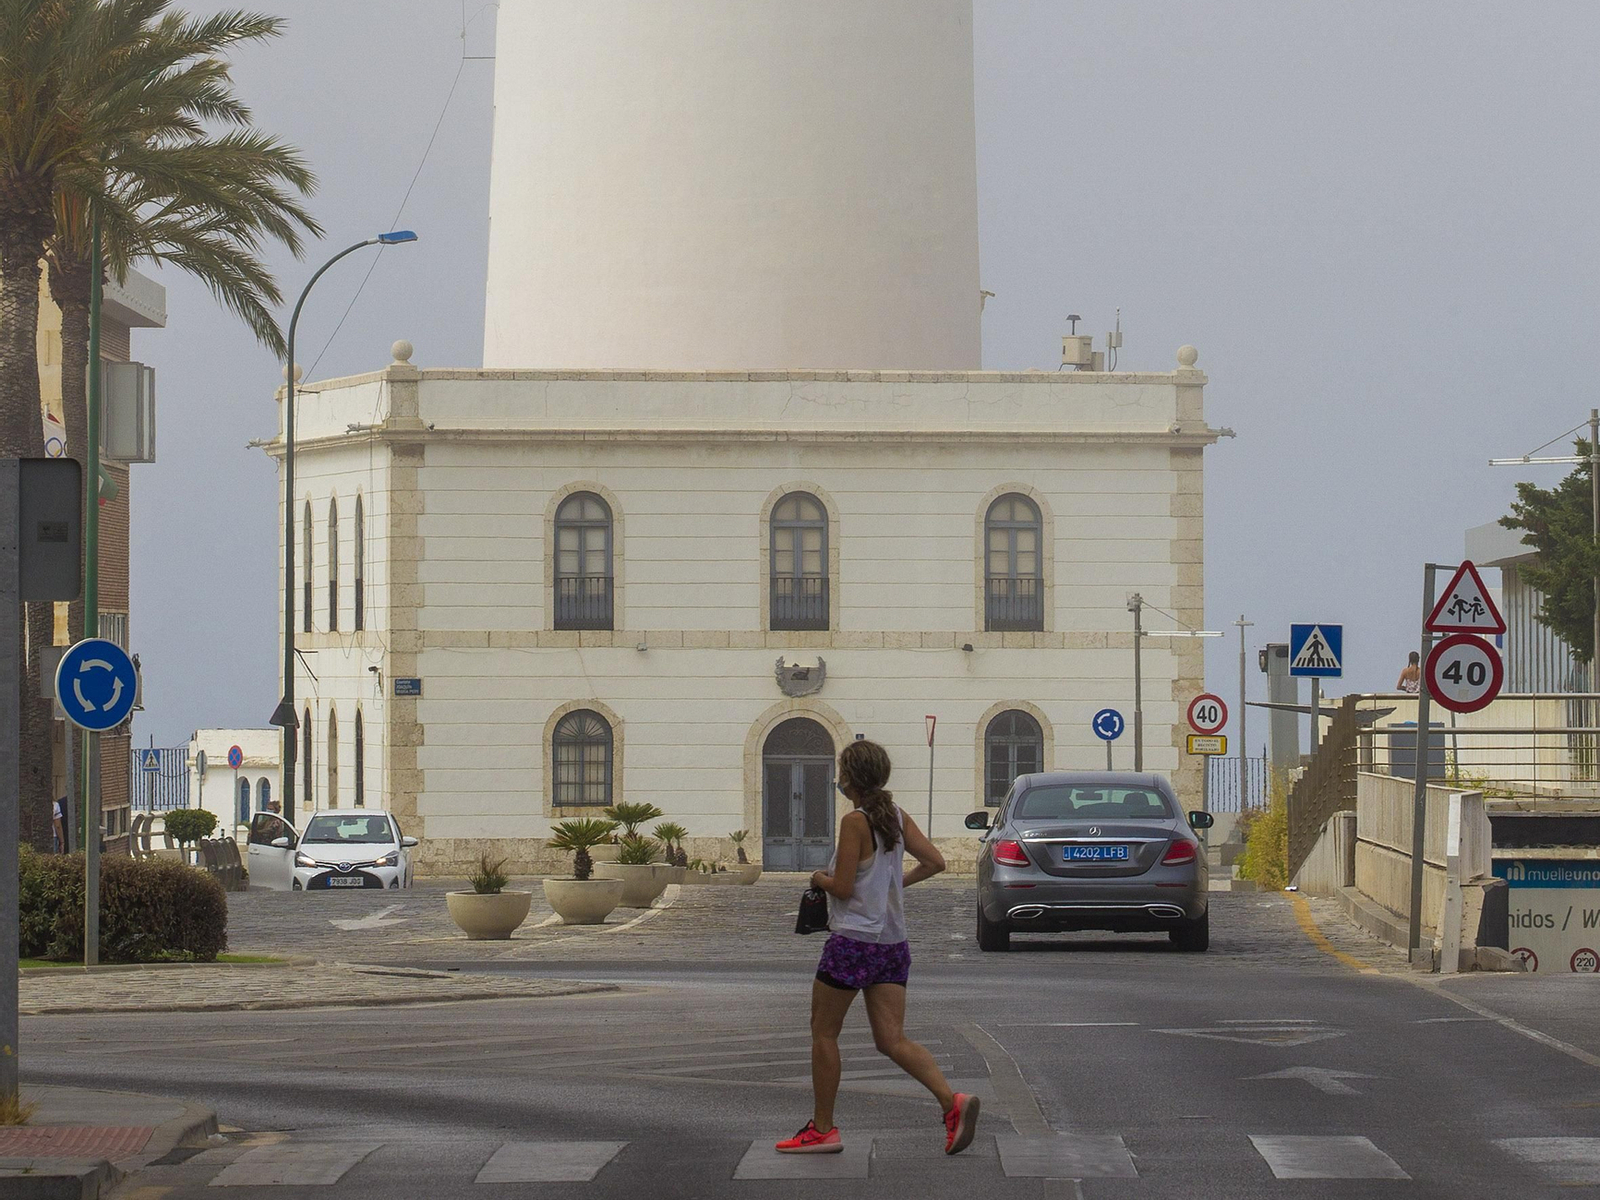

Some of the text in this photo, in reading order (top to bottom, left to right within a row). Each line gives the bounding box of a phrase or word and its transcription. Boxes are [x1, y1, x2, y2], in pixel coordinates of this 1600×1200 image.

[1442, 660, 1487, 686] 40
[1196, 705, 1218, 723] 40
[1073, 847, 1125, 858] 4202 LFB
[1527, 867, 1600, 881] muelleuno
